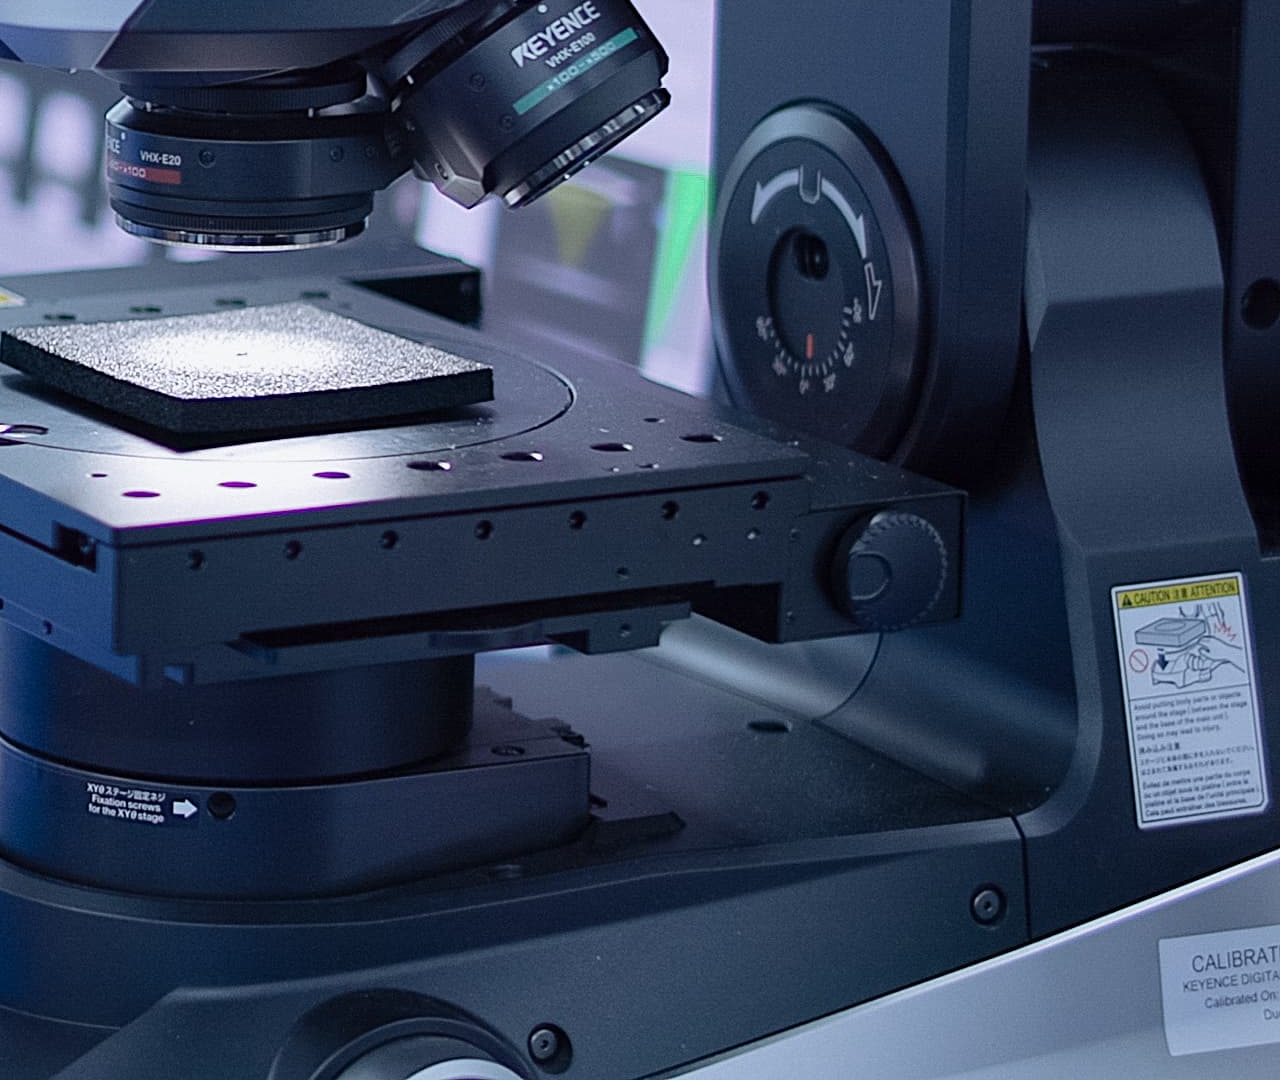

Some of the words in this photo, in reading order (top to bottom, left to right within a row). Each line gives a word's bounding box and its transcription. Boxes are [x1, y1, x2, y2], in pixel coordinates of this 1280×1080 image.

[511, 0, 601, 68] KEYENCE
[545, 32, 597, 68] VHX-E100
[140, 150, 181, 166] VHX-E20
[1134, 590, 1170, 605] CAUTION
[1190, 581, 1235, 598] ATTENTION
[92, 793, 126, 807] Fixation
[127, 801, 161, 813] screws
[88, 803, 100, 814] for
[102, 806, 116, 817] the
[137, 812, 165, 824] stage
[1183, 974, 1238, 992] KEYENCE
[1204, 992, 1257, 1008] Calibrated
